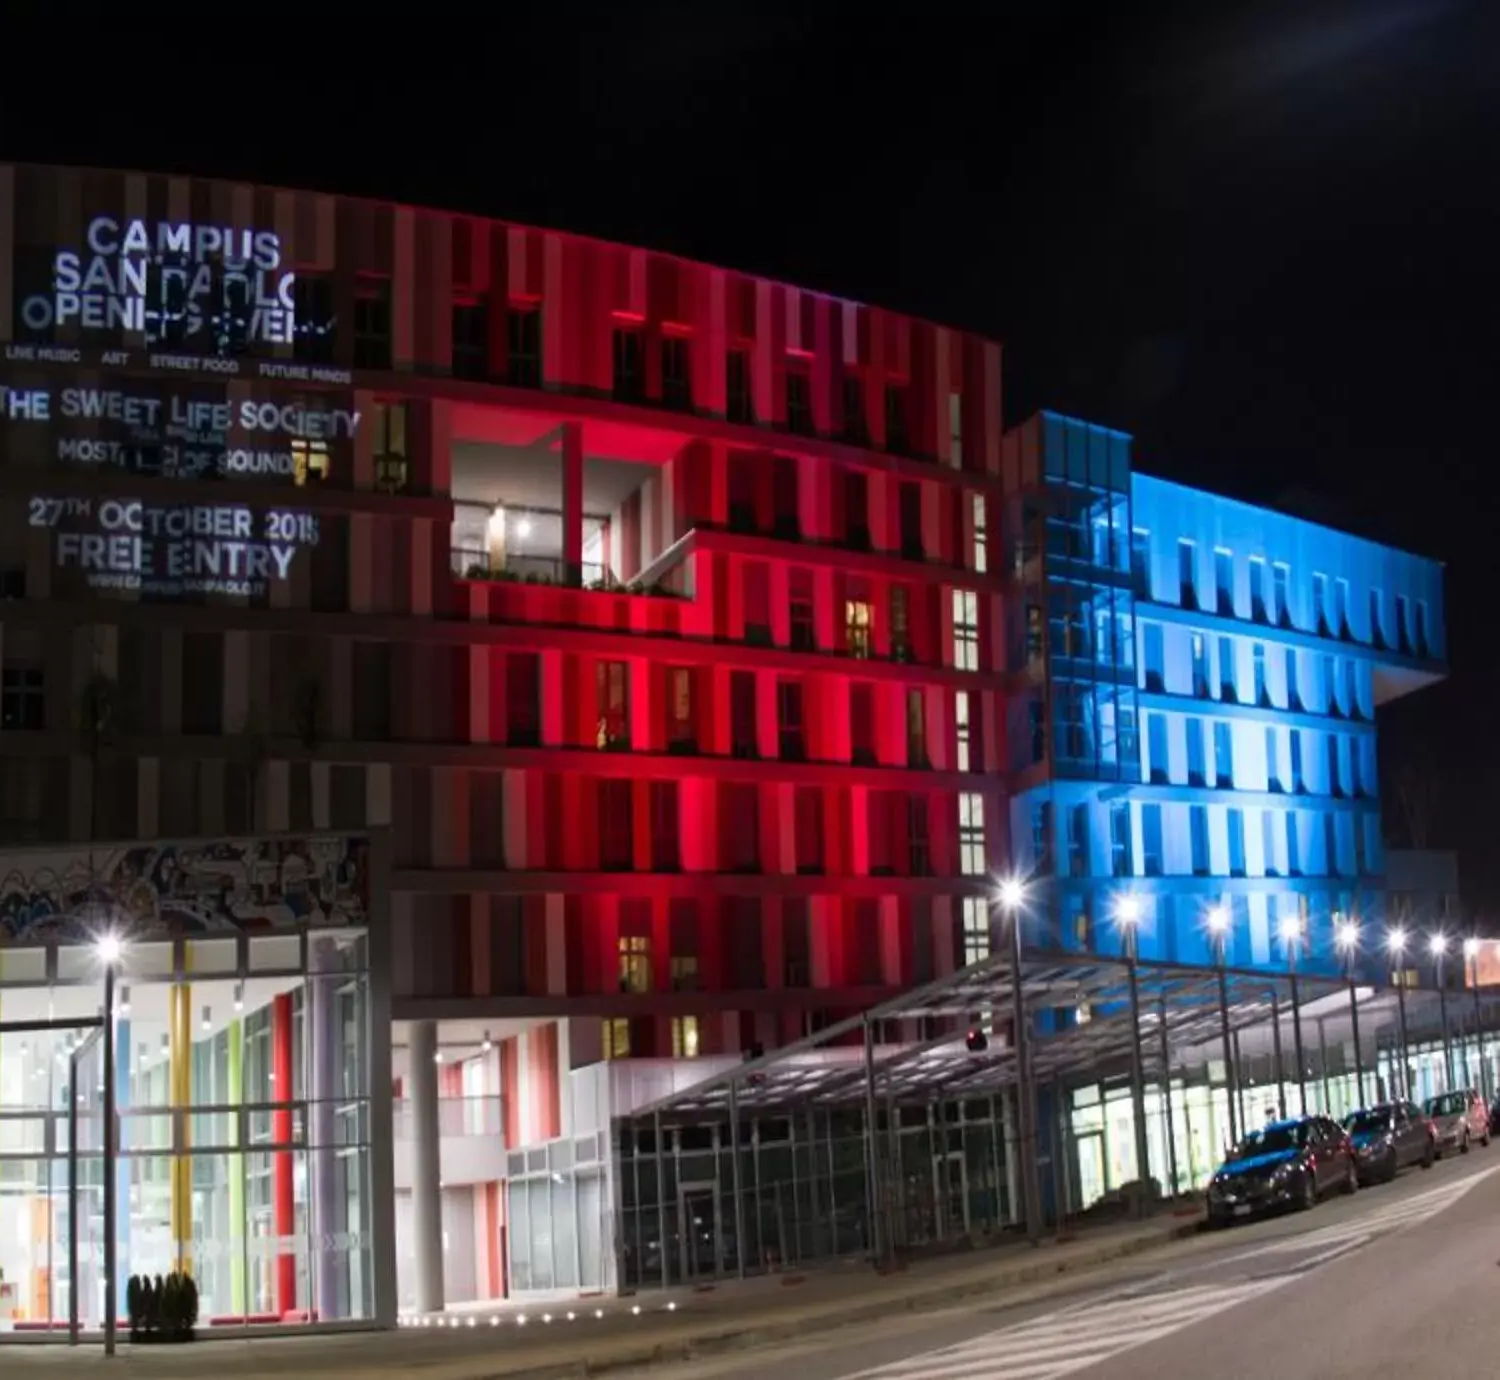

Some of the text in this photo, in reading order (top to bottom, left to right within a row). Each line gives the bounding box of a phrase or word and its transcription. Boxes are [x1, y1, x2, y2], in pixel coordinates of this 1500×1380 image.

[88, 218, 280, 270] CAMPUS
[60, 388, 161, 426] SWEET
[170, 395, 231, 431] LIFE
[240, 400, 361, 438] SOCIETY
[99, 501, 252, 537] OCTOBER
[56, 533, 296, 579] FREE ENTRY
